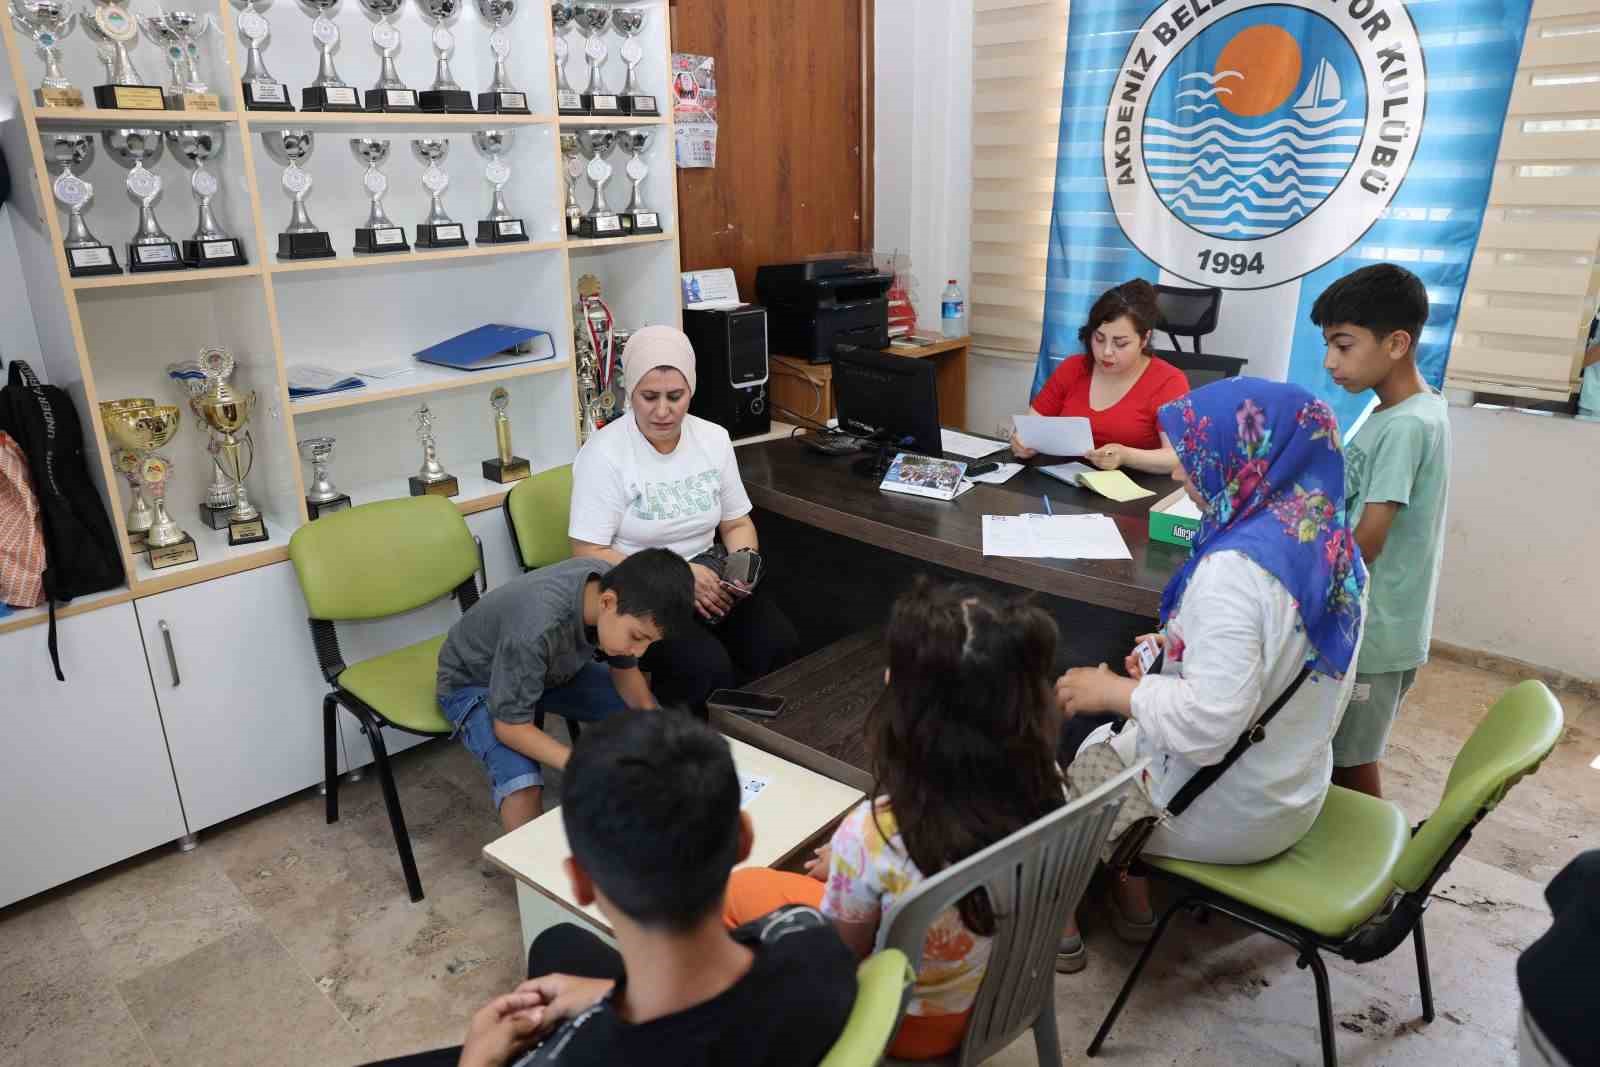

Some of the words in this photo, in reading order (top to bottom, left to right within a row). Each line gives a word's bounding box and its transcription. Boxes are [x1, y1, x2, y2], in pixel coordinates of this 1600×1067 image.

[1115, 47, 1157, 185] AKDENİZ
[1360, 42, 1410, 195] KULÜBÜ
[1198, 249, 1265, 276] 1994
